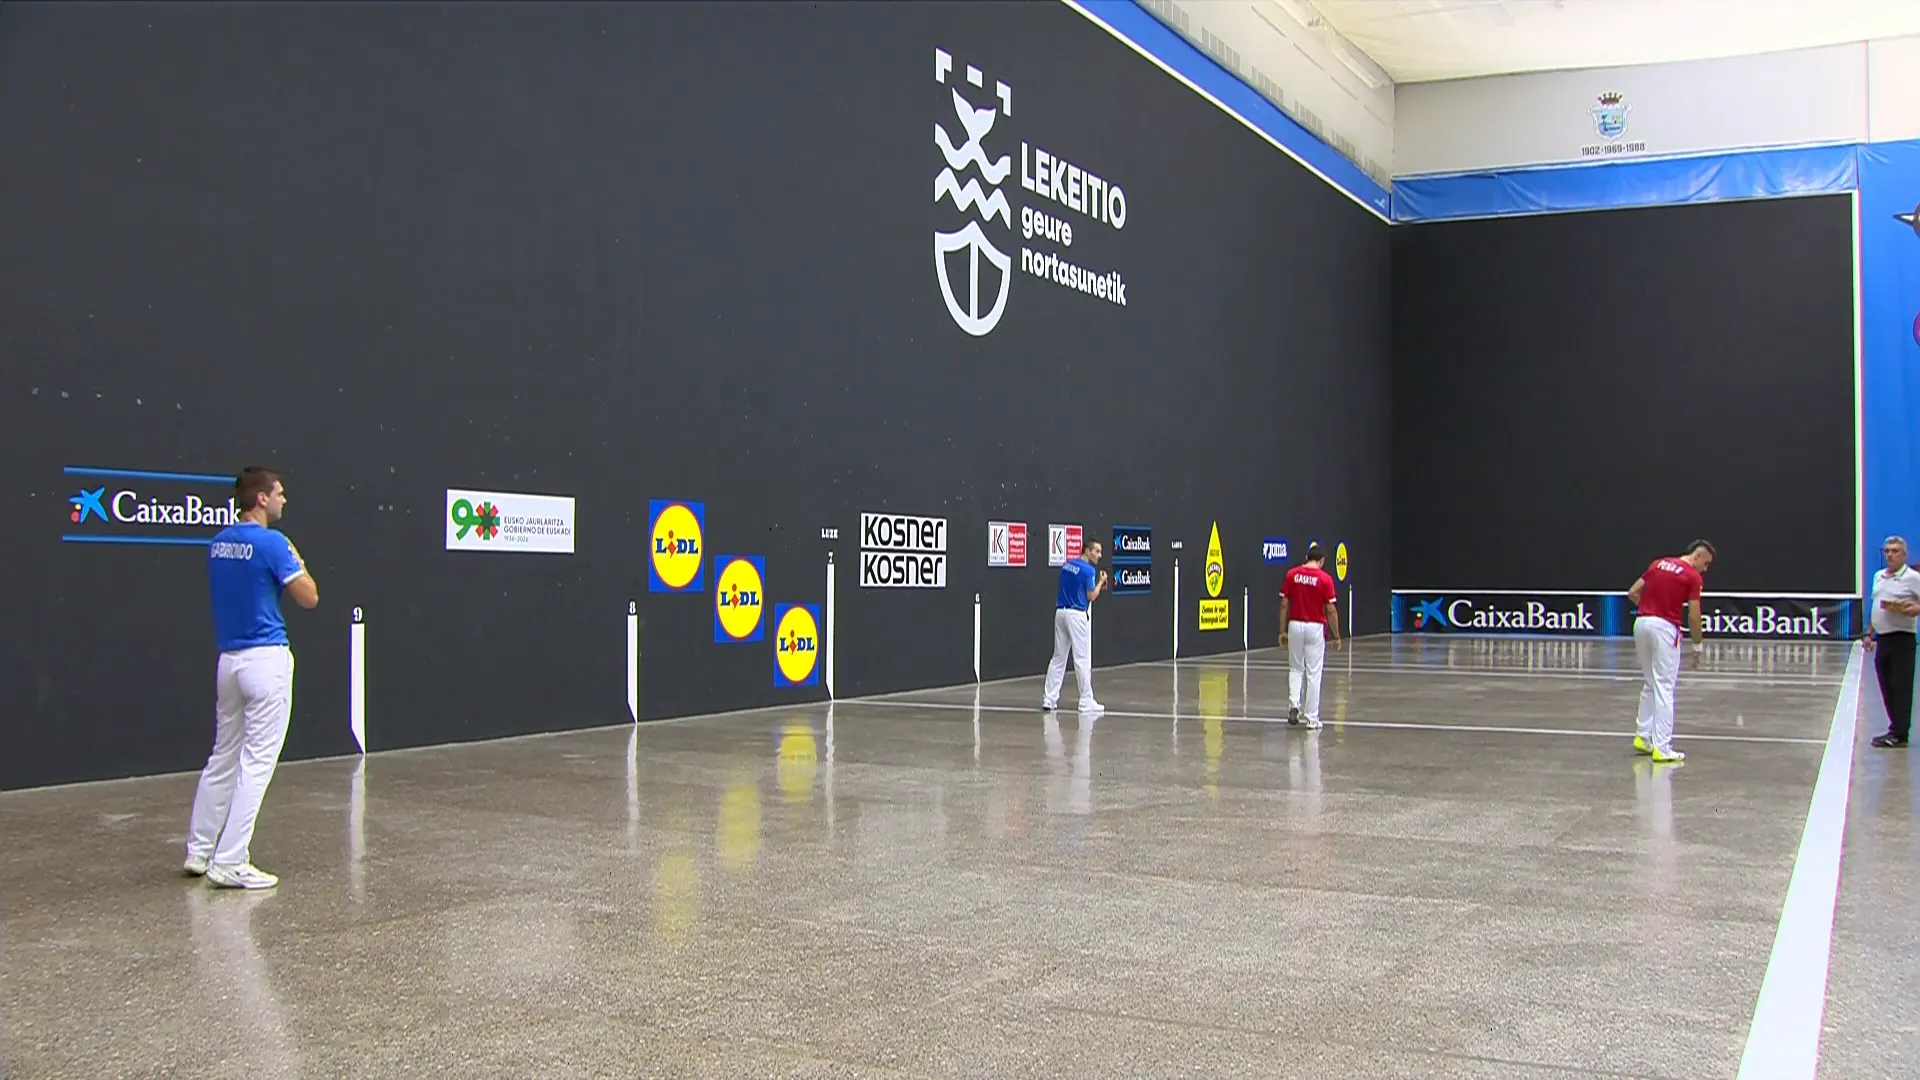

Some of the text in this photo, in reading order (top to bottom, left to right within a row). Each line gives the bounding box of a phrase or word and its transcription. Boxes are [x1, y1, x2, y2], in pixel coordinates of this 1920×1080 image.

[1021, 141, 1127, 229] LEKEITIO
[1021, 205, 1073, 247] geure
[1021, 246, 1127, 307] nortasunetik
[112, 490, 242, 526] CaixaBank
[504, 516, 564, 527] EUSKO JAURLARITZA
[503, 525, 536, 535] GOBIERNO
[537, 526, 545, 535] DE
[821, 528, 838, 539] LUZE
[1121, 535, 1151, 551] CaixaBank
[828, 552, 834, 563] 7
[1121, 569, 1151, 586] CaixaBank
[354, 606, 363, 622] 9
[628, 601, 637, 614] 8
[1448, 601, 1595, 632] CaixaBank
[1681, 602, 1830, 636] aixaBank
